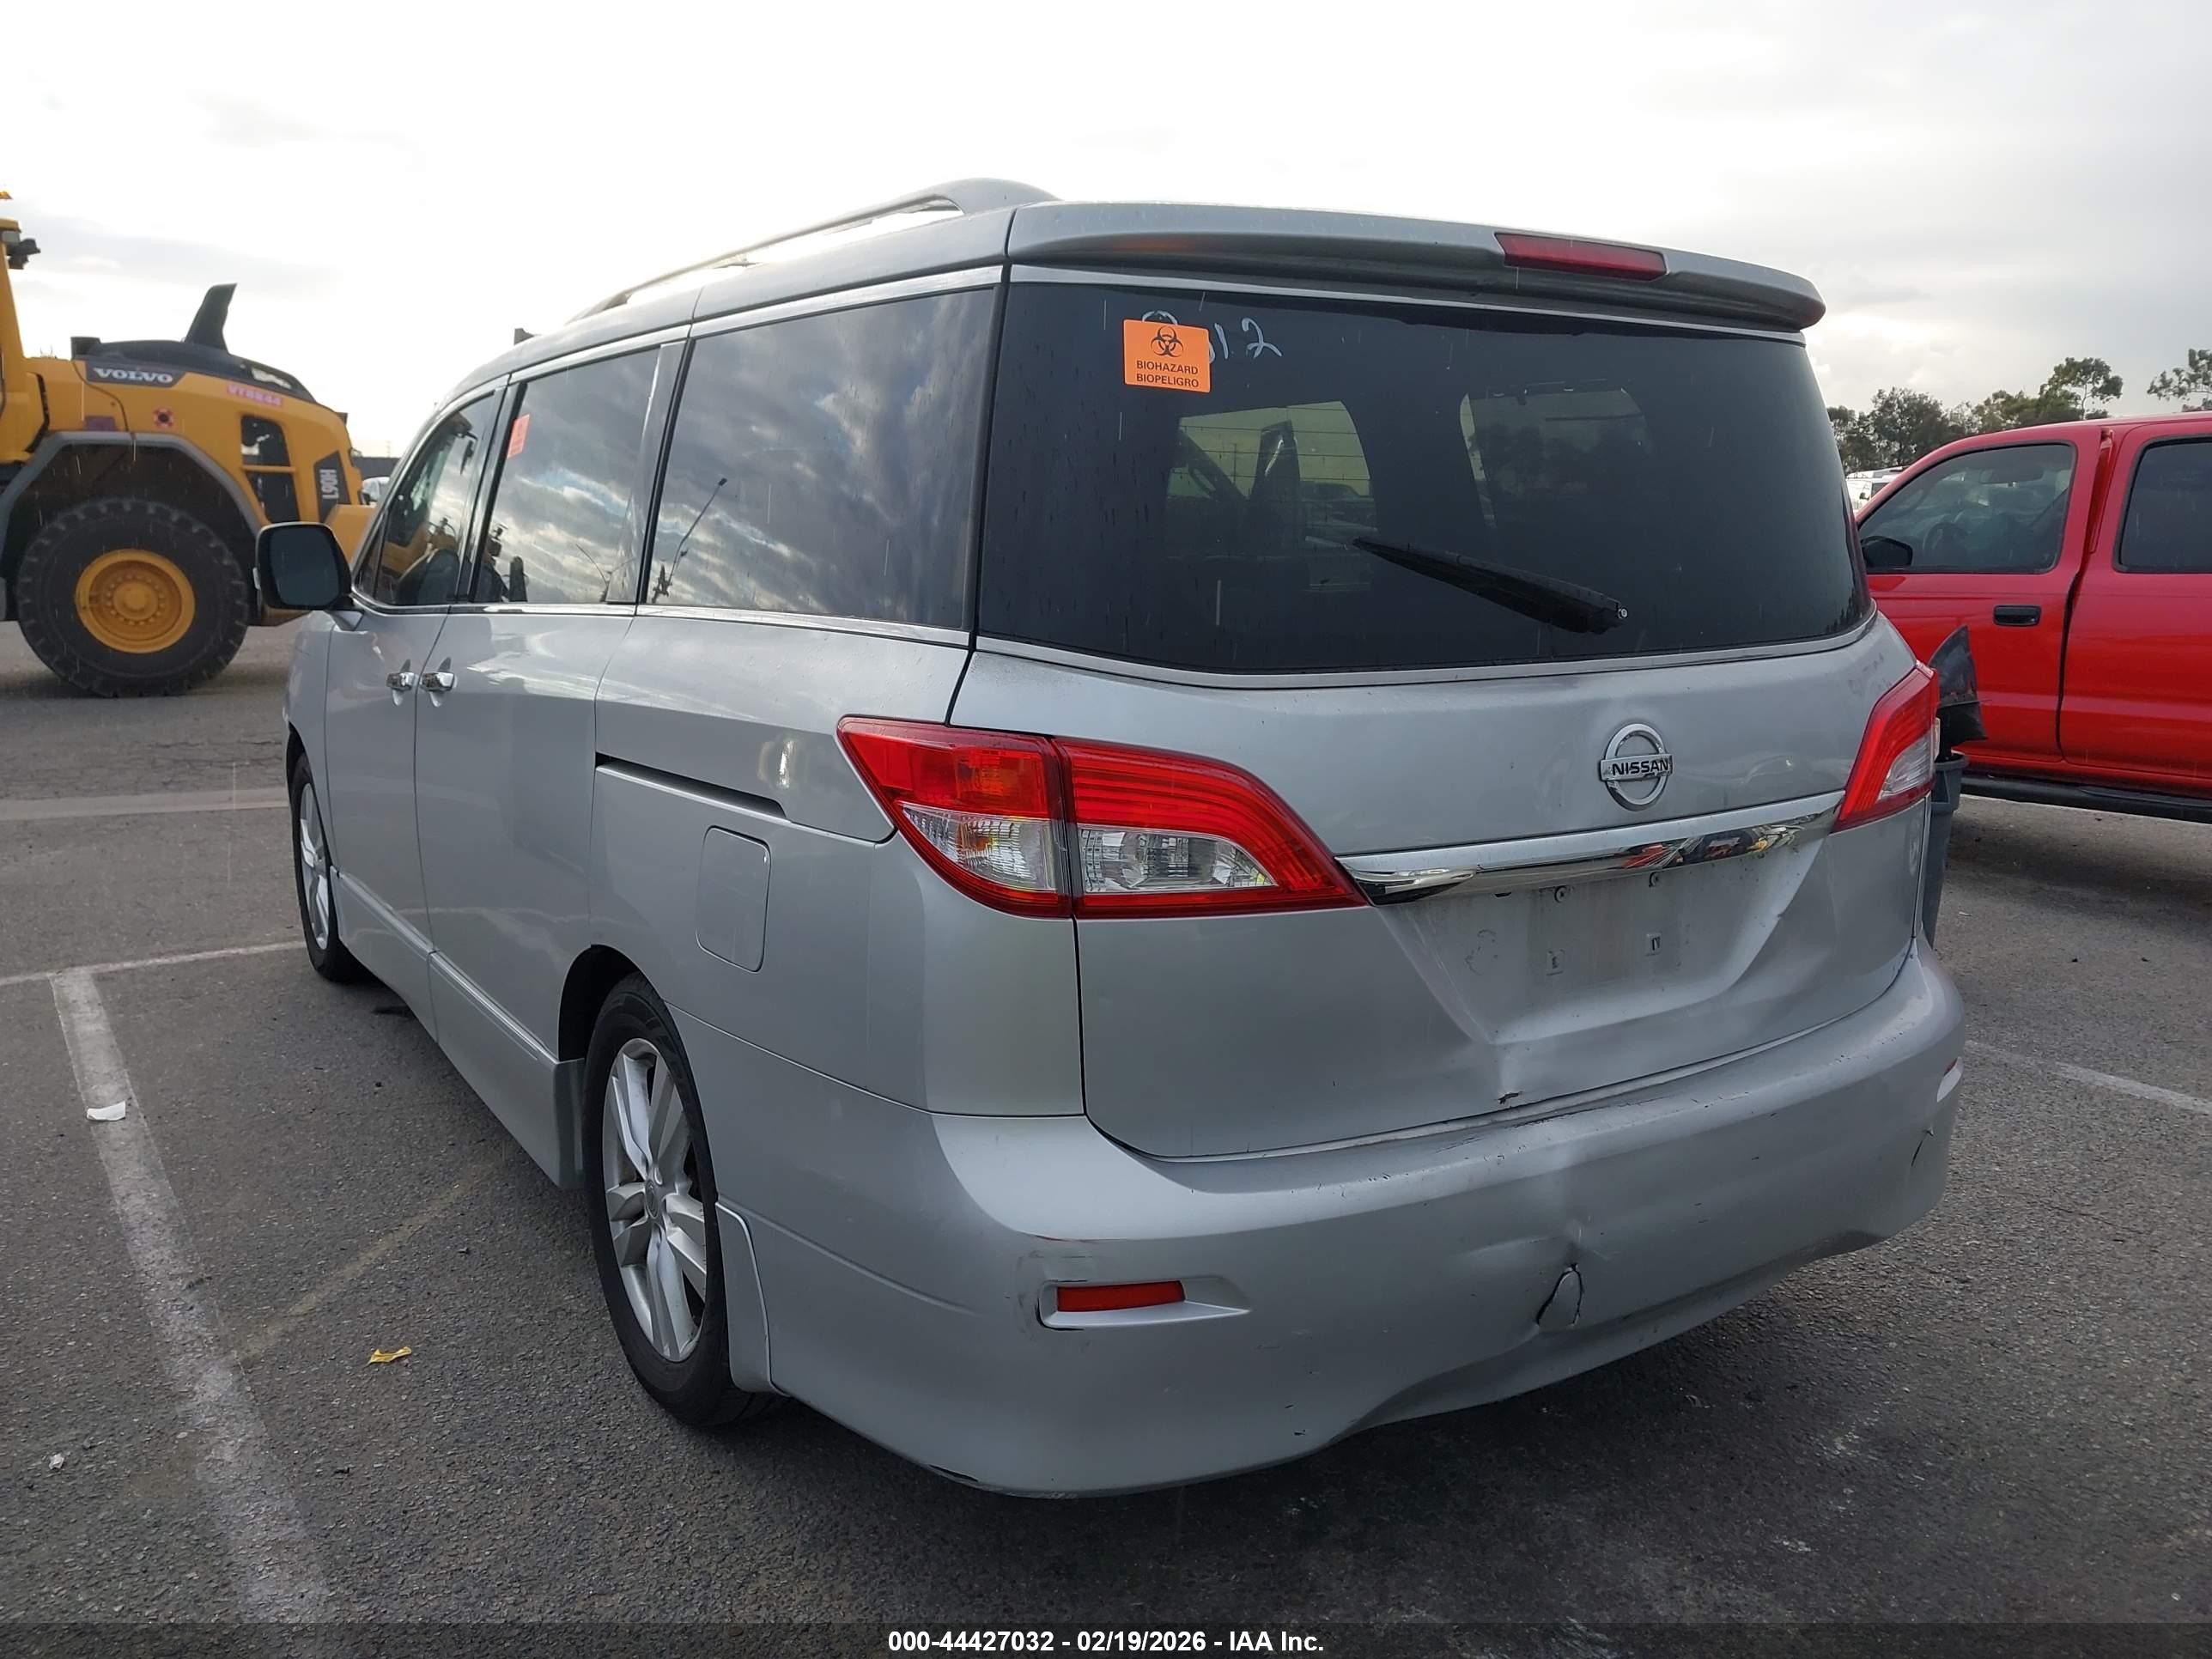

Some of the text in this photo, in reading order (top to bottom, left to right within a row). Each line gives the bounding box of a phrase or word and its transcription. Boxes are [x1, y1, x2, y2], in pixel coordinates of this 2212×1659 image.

[94, 367, 173, 383] VOLVO
[1136, 360, 1199, 375] BIOHAZARD
[1136, 373, 1200, 387] BIOPELIGRO
[319, 469, 339, 499] L90H
[1611, 759, 1669, 776] NISSAN
